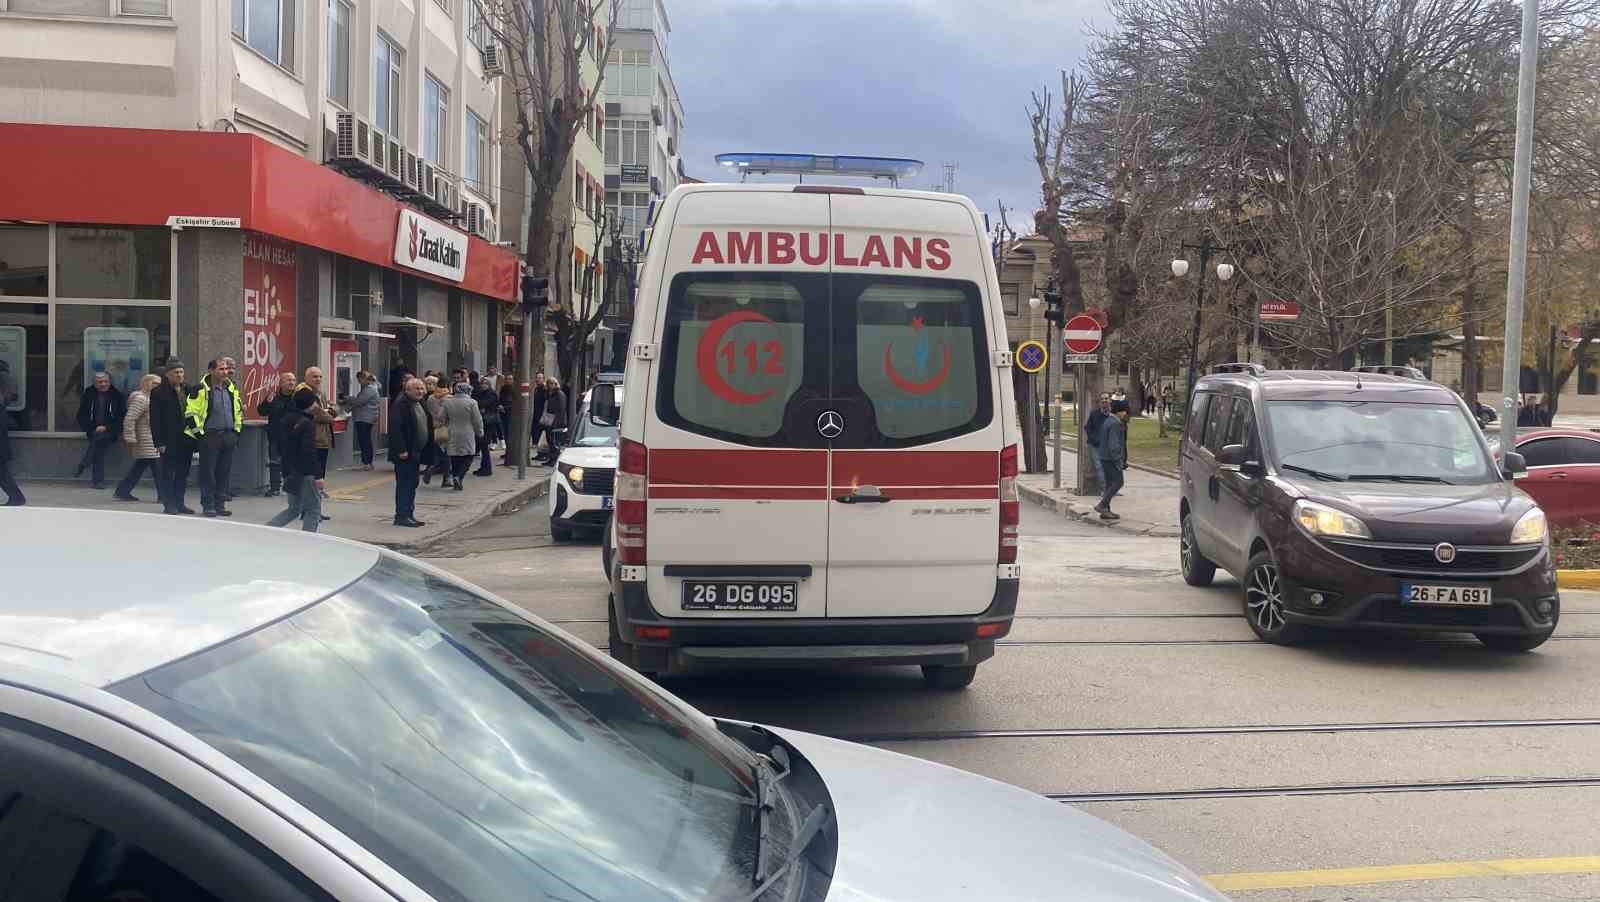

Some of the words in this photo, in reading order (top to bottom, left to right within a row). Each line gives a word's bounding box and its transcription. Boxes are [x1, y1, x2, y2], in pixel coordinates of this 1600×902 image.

[419, 228, 439, 263] Ziraat
[692, 231, 952, 271] AMBULANS
[720, 340, 785, 375] 112
[693, 585, 717, 603] 26
[726, 585, 754, 603] DG
[758, 585, 794, 603] 095
[1411, 587, 1429, 601] 26
[1437, 588, 1458, 602] FA
[1462, 589, 1489, 603] 691
